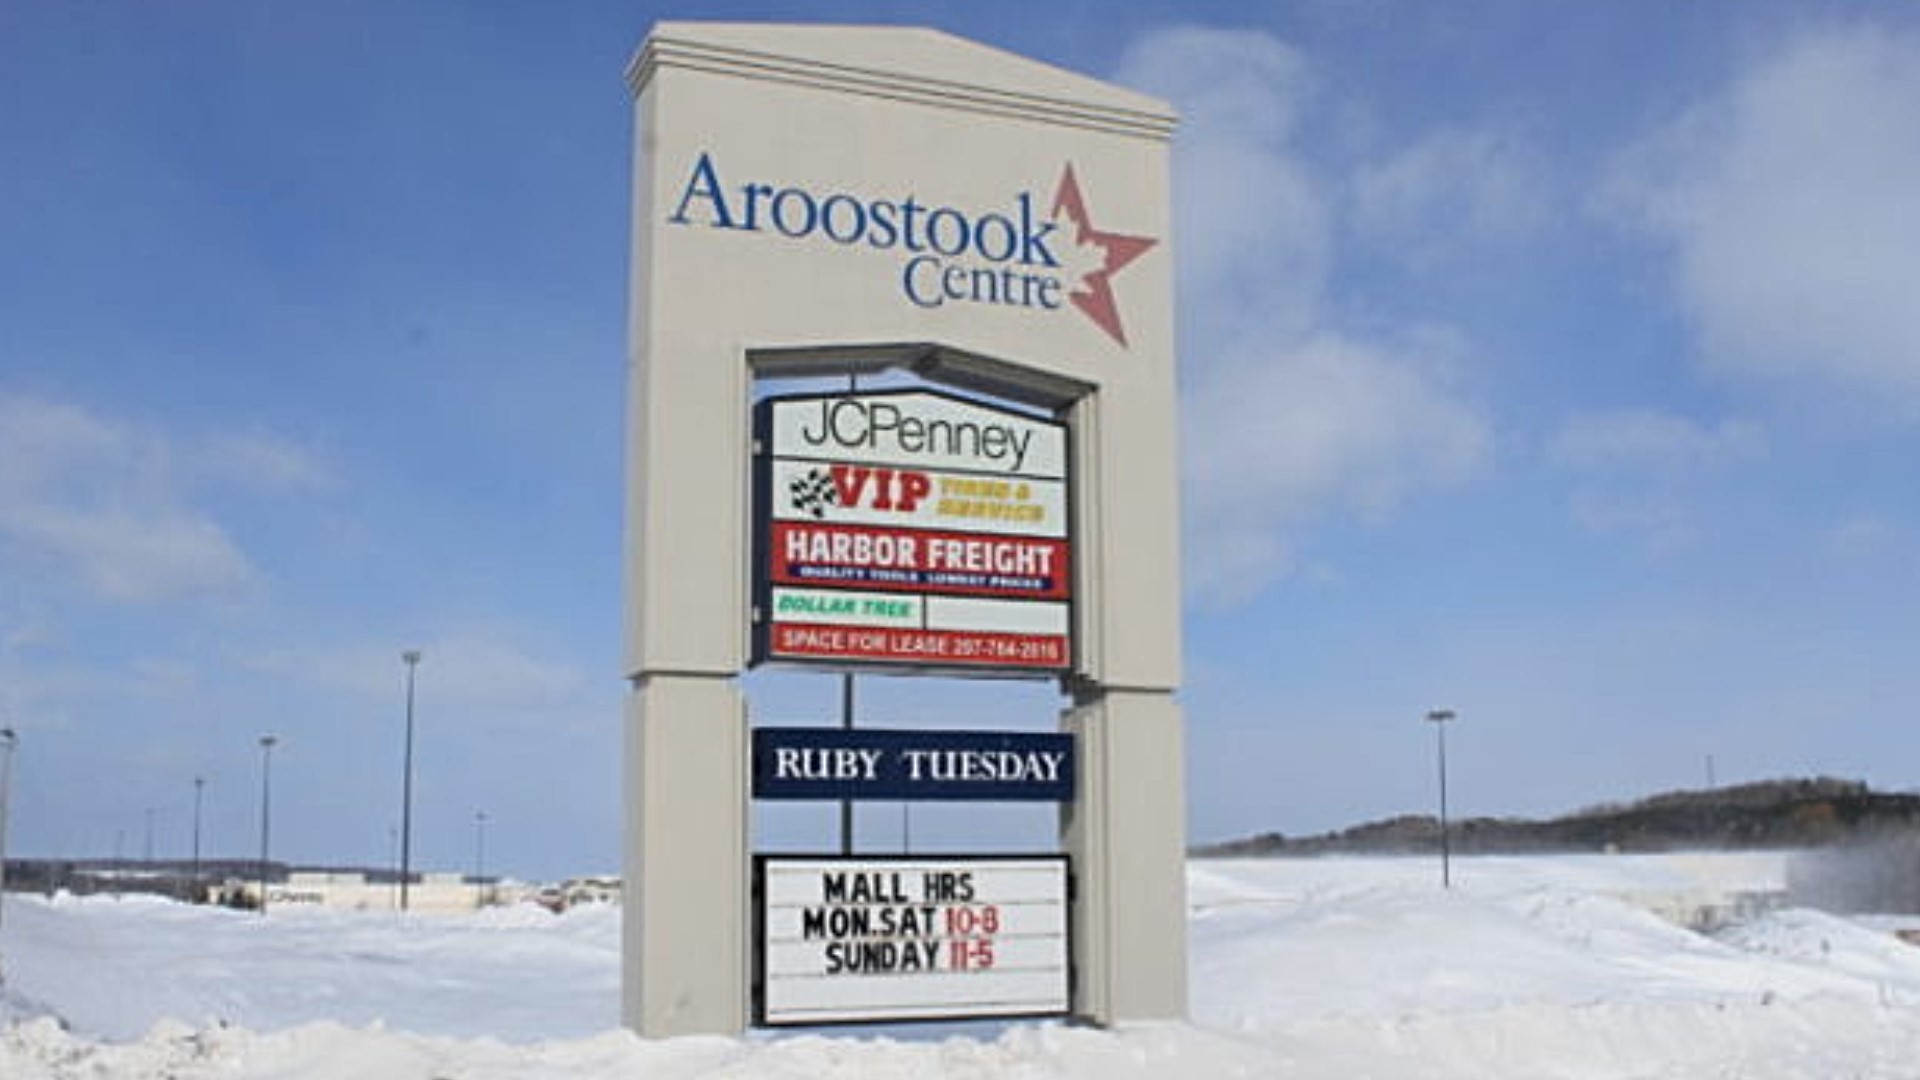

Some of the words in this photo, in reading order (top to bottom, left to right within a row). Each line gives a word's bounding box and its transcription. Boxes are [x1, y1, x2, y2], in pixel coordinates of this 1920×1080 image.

[668, 152, 1062, 267] Aroostook
[903, 257, 1062, 309] Centre
[803, 399, 1031, 470] JCPenney
[829, 466, 931, 512] VIP
[786, 530, 918, 567] HARBOR
[927, 537, 1054, 576] FREIGHT
[778, 595, 856, 614] DOLLAR
[863, 599, 912, 618] TREE
[783, 629, 847, 651] SPACE
[850, 631, 887, 653] FOR
[891, 633, 947, 656] LEASE
[776, 748, 882, 779] RUBY
[903, 750, 1064, 781] TUESDAY
[823, 872, 908, 904] MALL
[923, 872, 975, 901] HRS
[944, 906, 999, 935] 10-8
[825, 941, 940, 974] SUNDAY
[950, 938, 994, 970] 11-5
